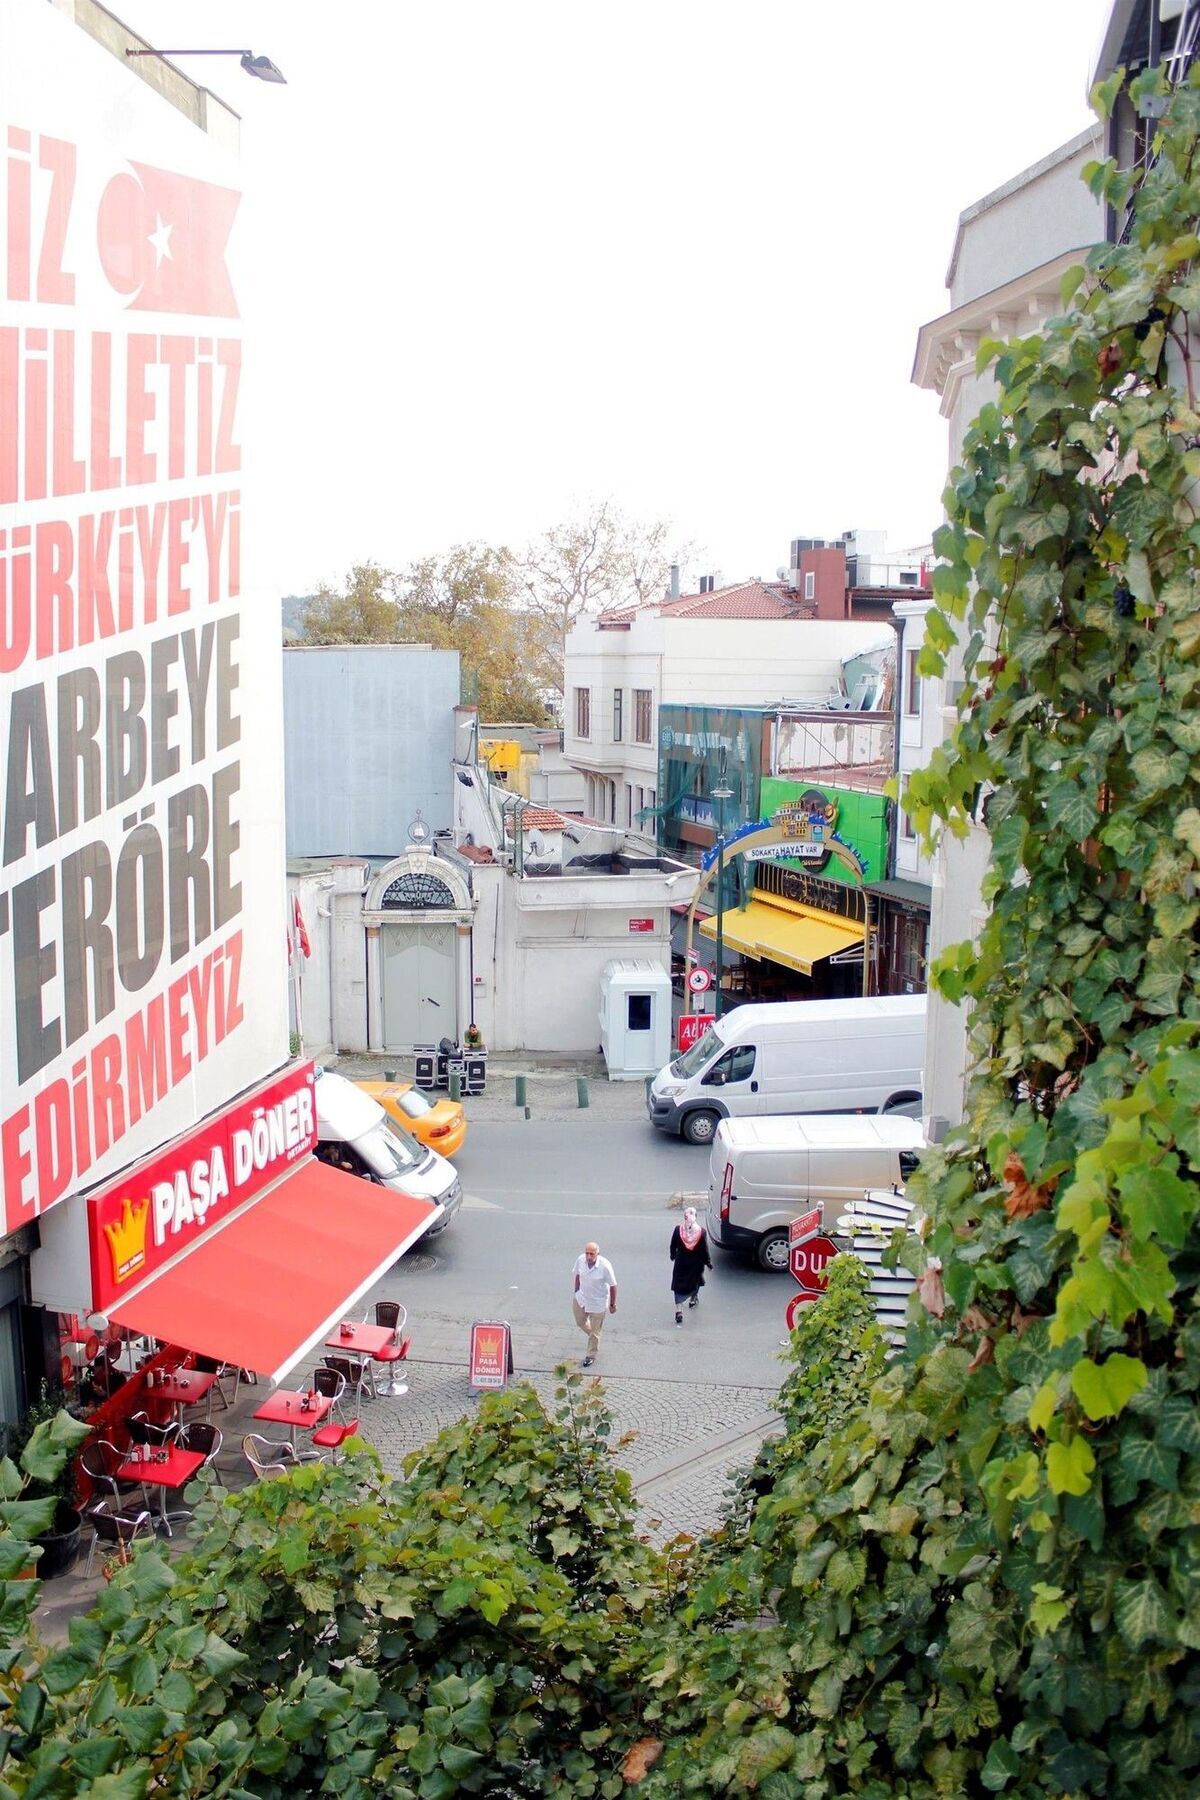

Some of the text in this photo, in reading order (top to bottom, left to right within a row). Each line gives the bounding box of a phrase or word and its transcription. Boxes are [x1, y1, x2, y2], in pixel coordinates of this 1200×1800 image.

[752, 845, 817, 857] SOKAKTA HAYAT VAR
[151, 1087, 315, 1247] PAŞA DÖNER
[475, 1366, 501, 1375] DÖNER
